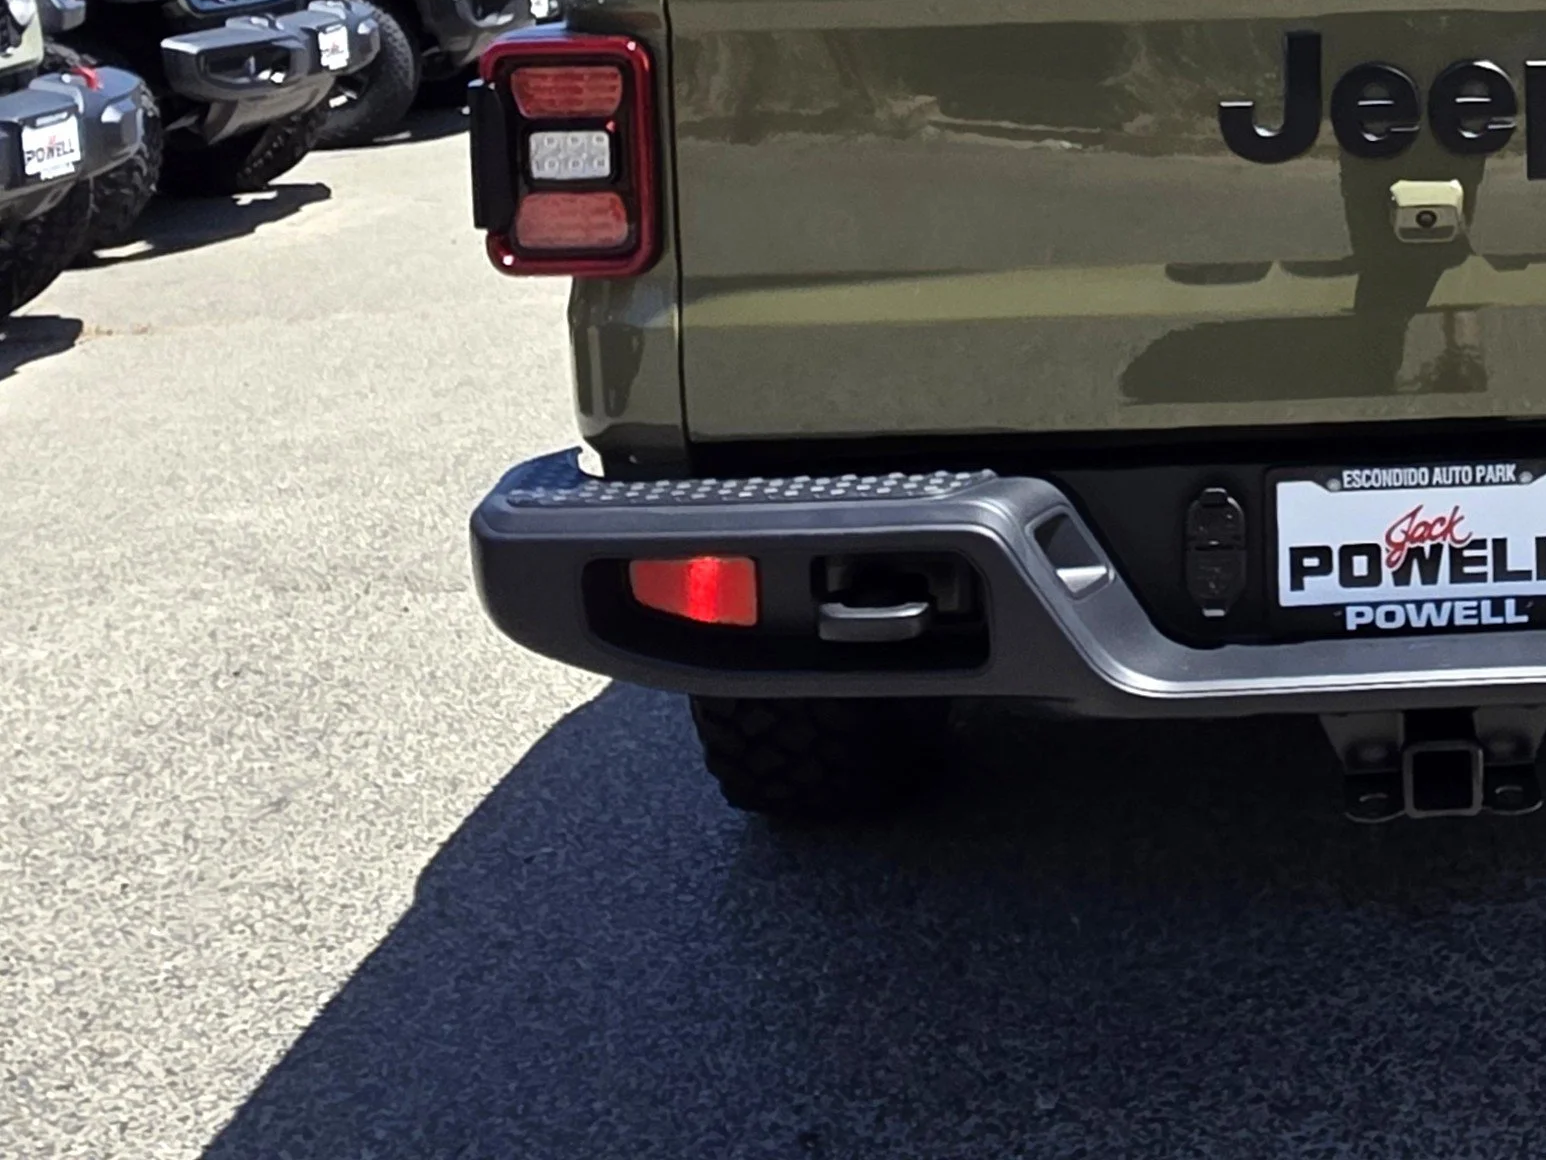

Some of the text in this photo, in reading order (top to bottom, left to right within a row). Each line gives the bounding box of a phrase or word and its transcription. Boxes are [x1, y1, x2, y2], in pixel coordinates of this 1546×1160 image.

[1342, 463, 1517, 489] ESCONDIDO AUTO PARK
[1385, 504, 1473, 568] Jack
[1345, 598, 1529, 631] POWELL
